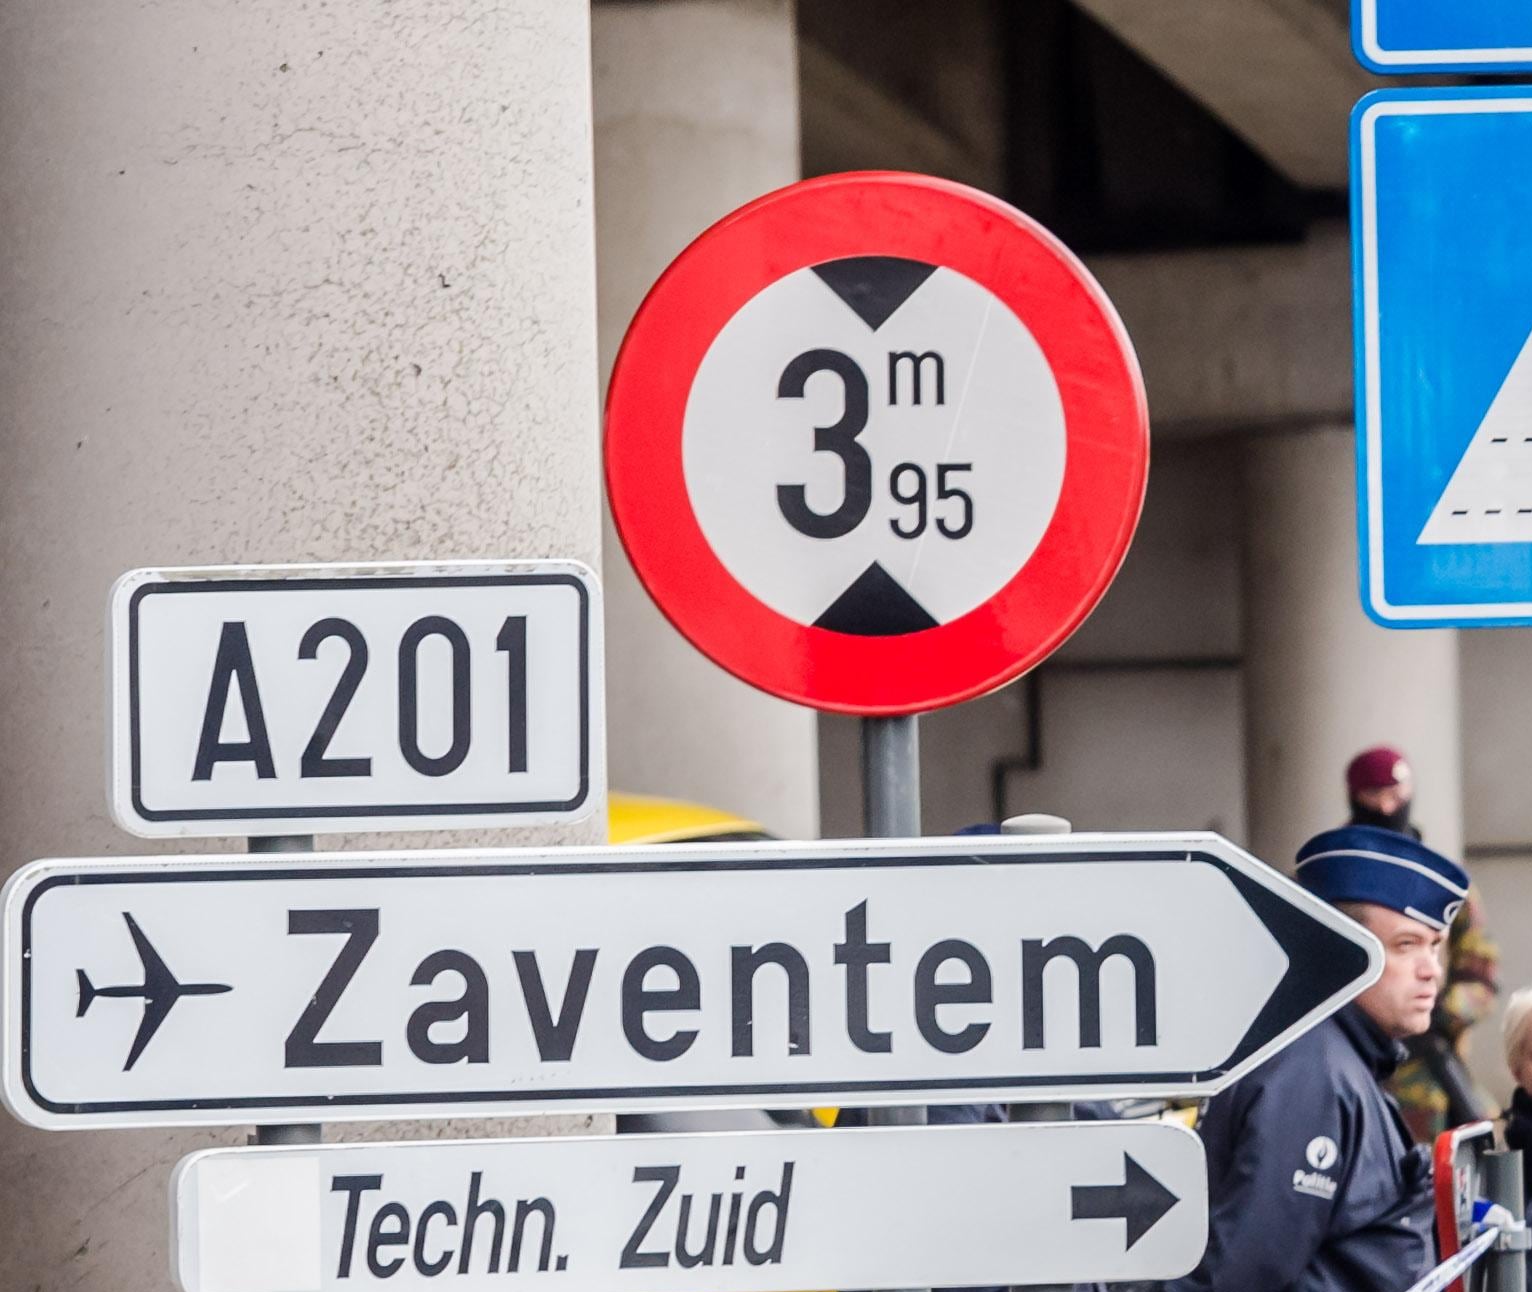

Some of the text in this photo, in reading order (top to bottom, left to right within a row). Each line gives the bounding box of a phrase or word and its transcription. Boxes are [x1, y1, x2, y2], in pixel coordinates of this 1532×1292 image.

[776, 348, 974, 540] 3 m 95
[191, 615, 529, 783] A201
[284, 899, 1158, 1069] Zaventem
[331, 1161, 795, 1280] Techn. Zuid
